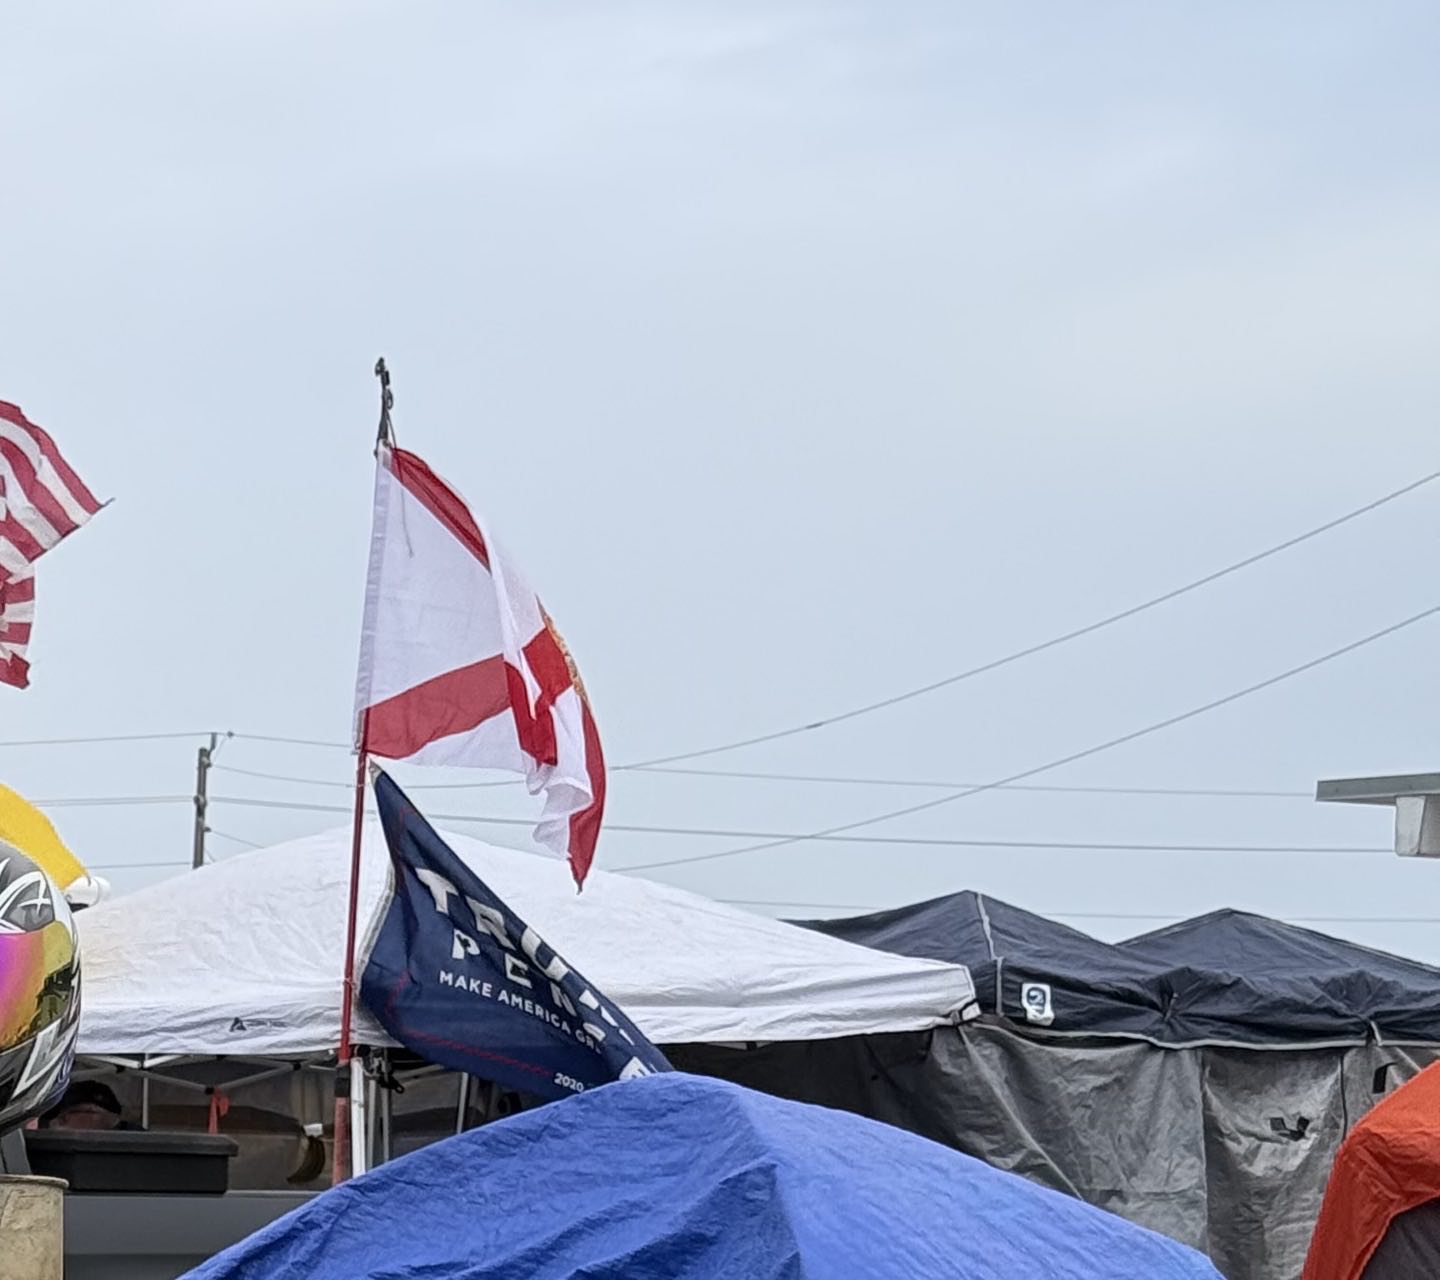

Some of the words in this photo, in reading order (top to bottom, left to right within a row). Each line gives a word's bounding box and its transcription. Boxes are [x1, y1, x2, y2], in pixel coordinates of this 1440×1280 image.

[439, 970, 492, 998] MAKE
[497, 989, 572, 1036] AMERICA
[554, 1072, 585, 1093] 2020
